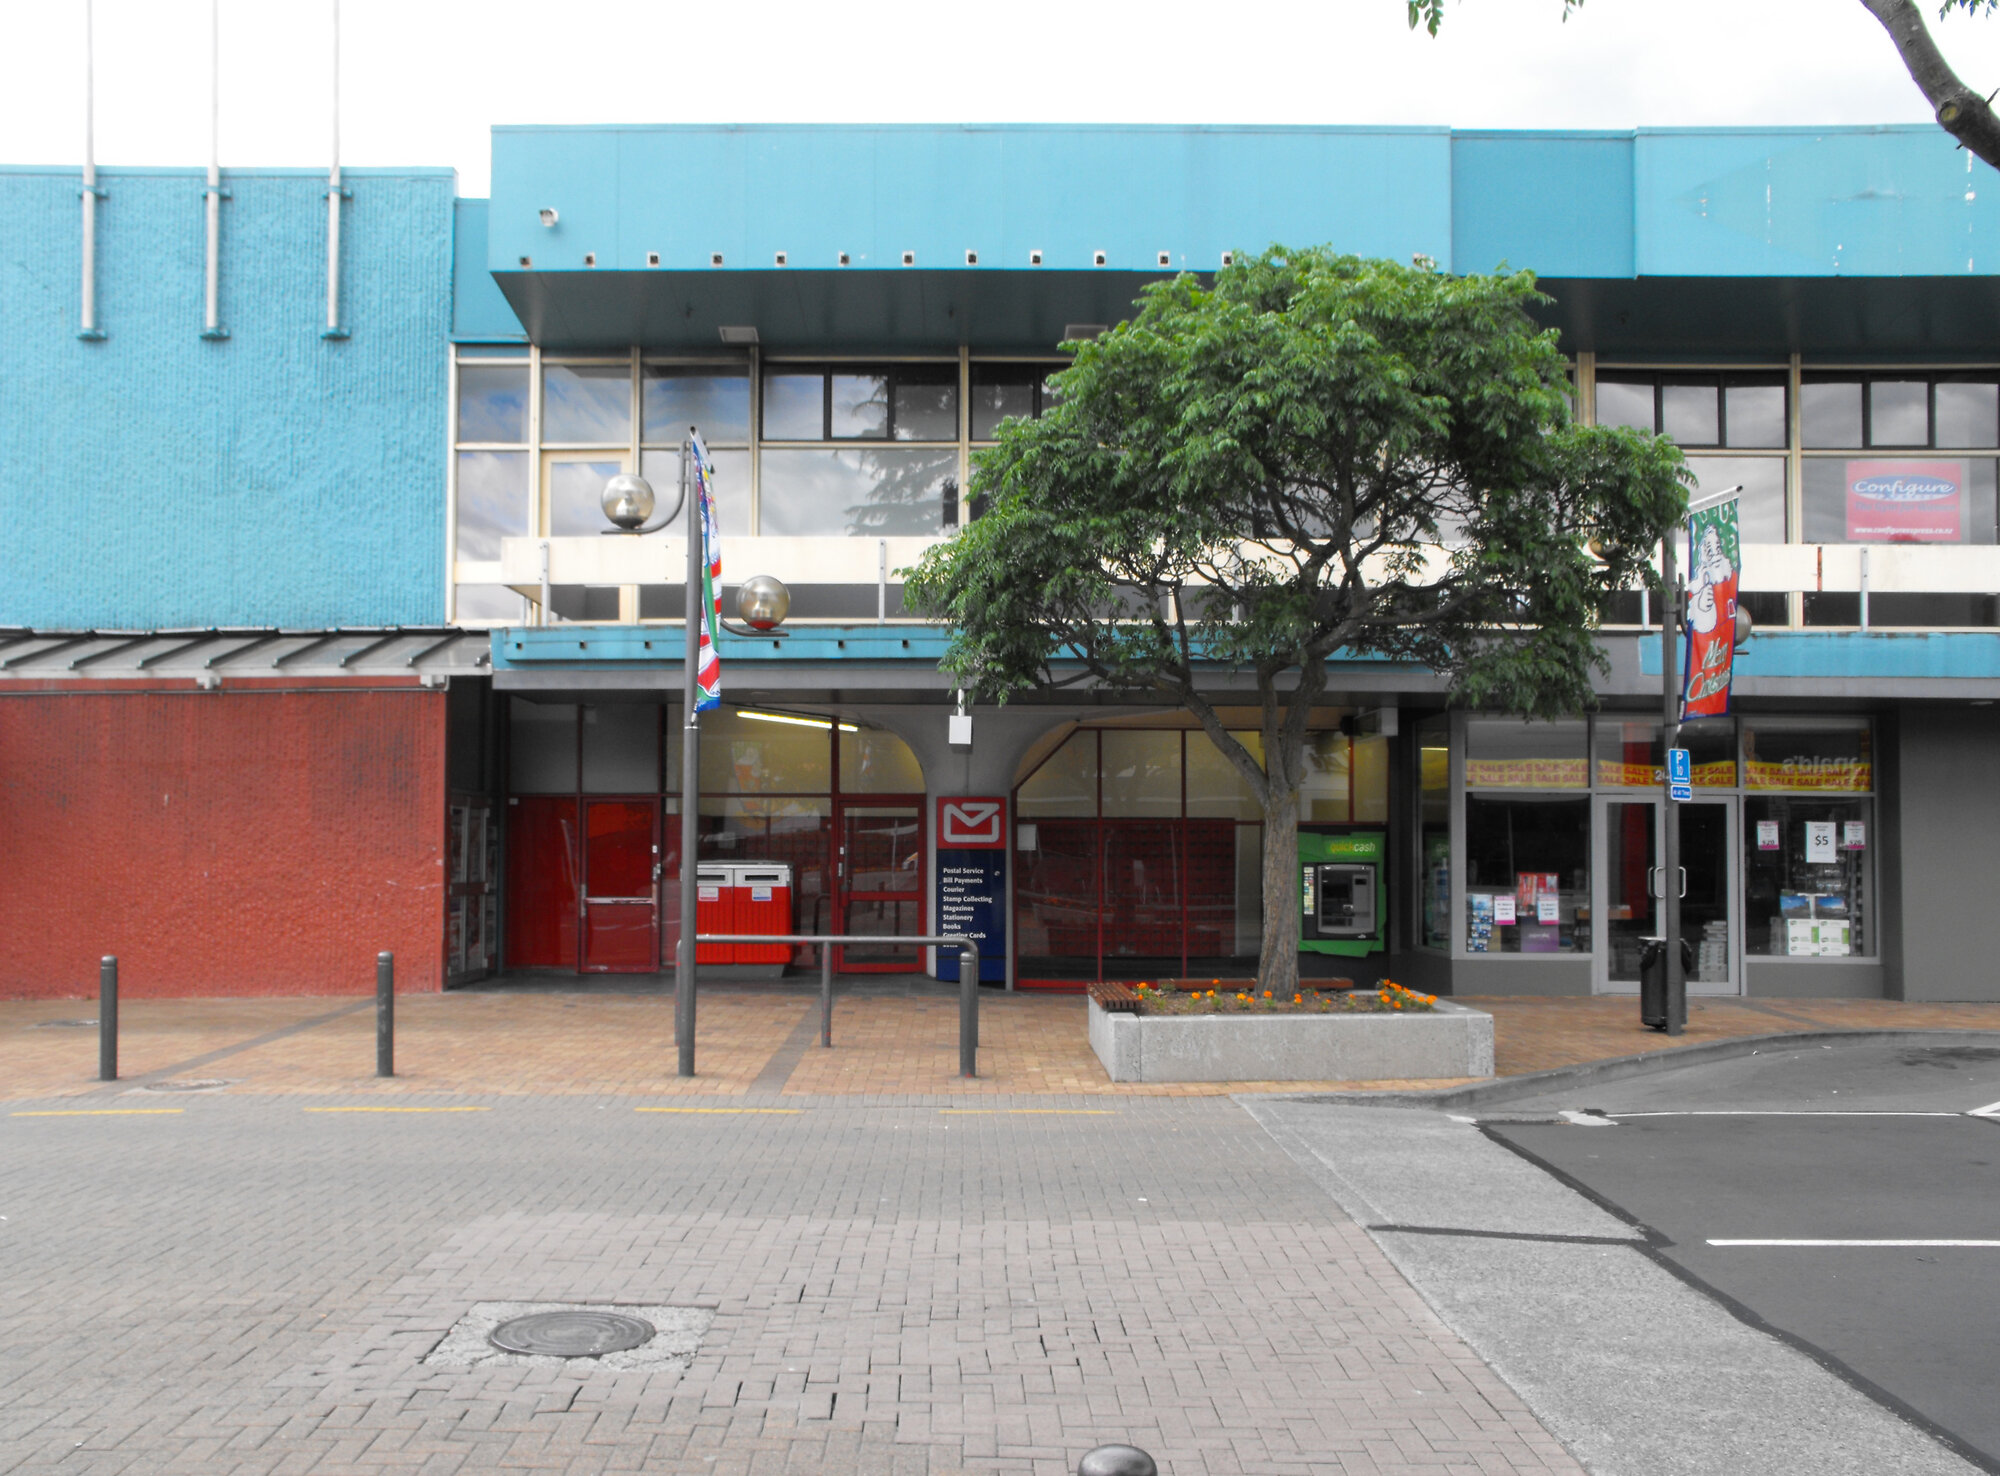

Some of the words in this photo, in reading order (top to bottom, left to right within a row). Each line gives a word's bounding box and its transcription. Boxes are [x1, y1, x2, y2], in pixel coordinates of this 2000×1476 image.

[1854, 480, 1954, 497] Configure
[1687, 667, 1731, 702] Christmas
[1676, 751, 1684, 764] P
[1624, 766, 1649, 775] SALE
[1708, 766, 1733, 775] SALE
[1624, 776, 1649, 785] SALE
[1708, 776, 1733, 785] SALE
[1769, 777, 1794, 786] SALE
[1797, 777, 1822, 786] SALE
[1815, 834, 1829, 847] $5
[1330, 841, 1376, 854] quickcash
[954, 877, 983, 885] Payments
[963, 896, 993, 904] Collecting
[943, 905, 974, 913] Magazines
[943, 914, 974, 922] Stationery
